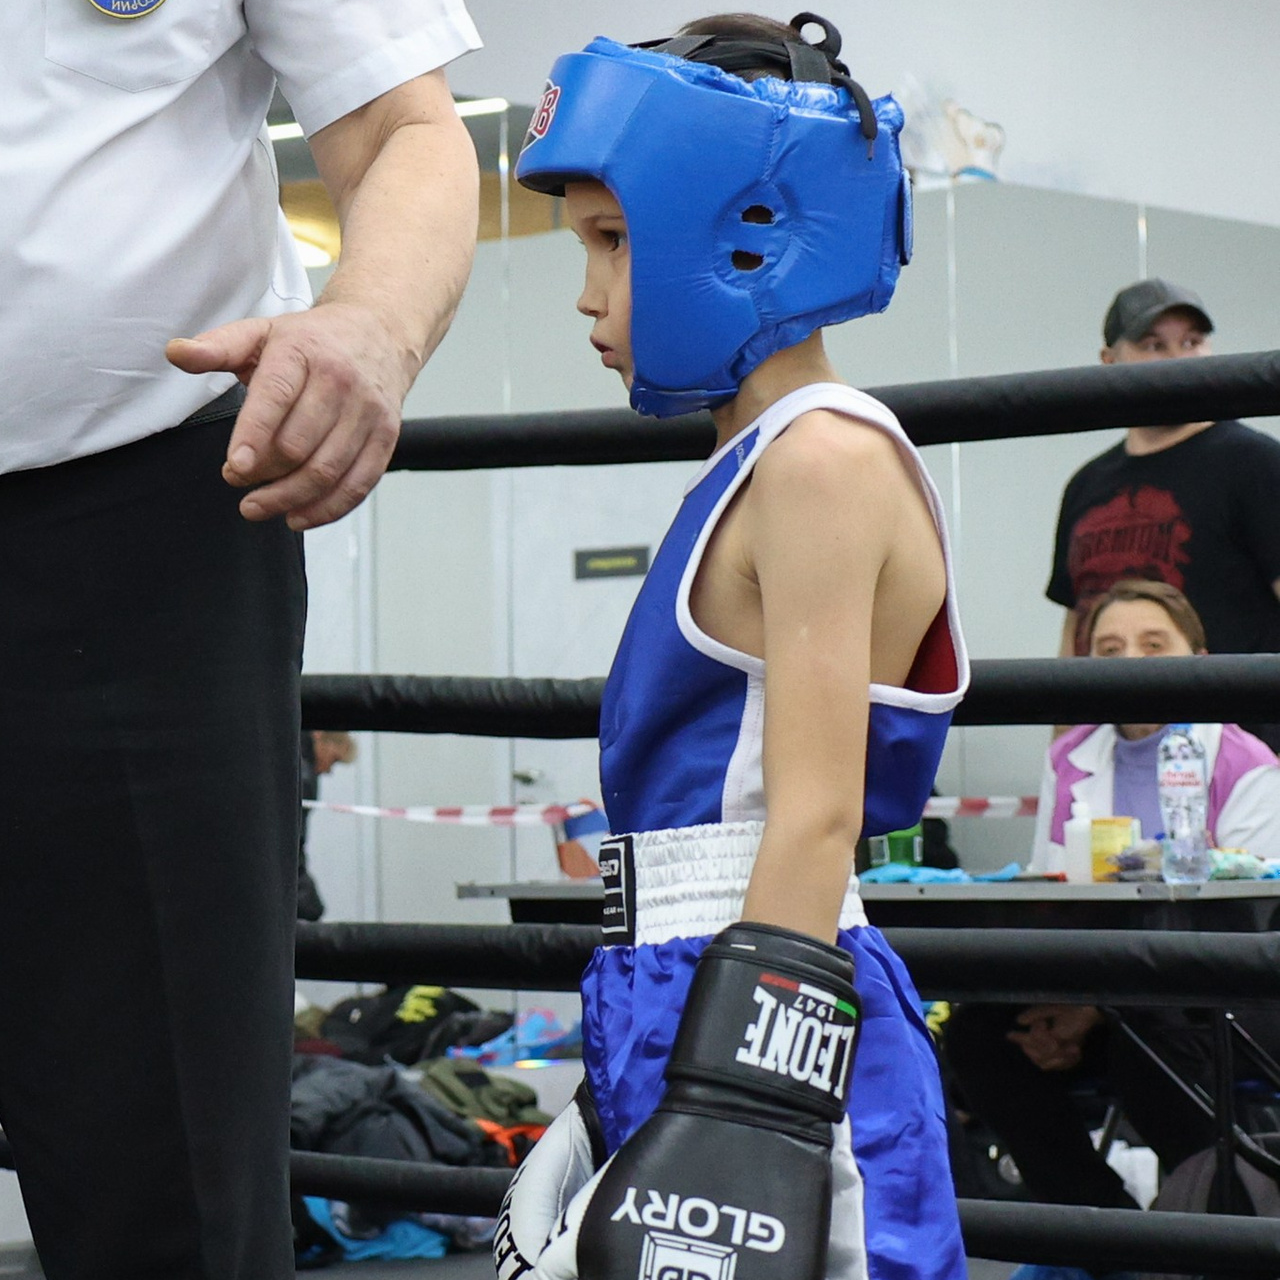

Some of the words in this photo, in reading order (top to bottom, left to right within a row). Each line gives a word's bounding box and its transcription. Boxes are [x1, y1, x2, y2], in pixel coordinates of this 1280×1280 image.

[792, 994, 836, 1021] 1947
[734, 984, 856, 1101] LEONE
[609, 1186, 786, 1254] GLORY
